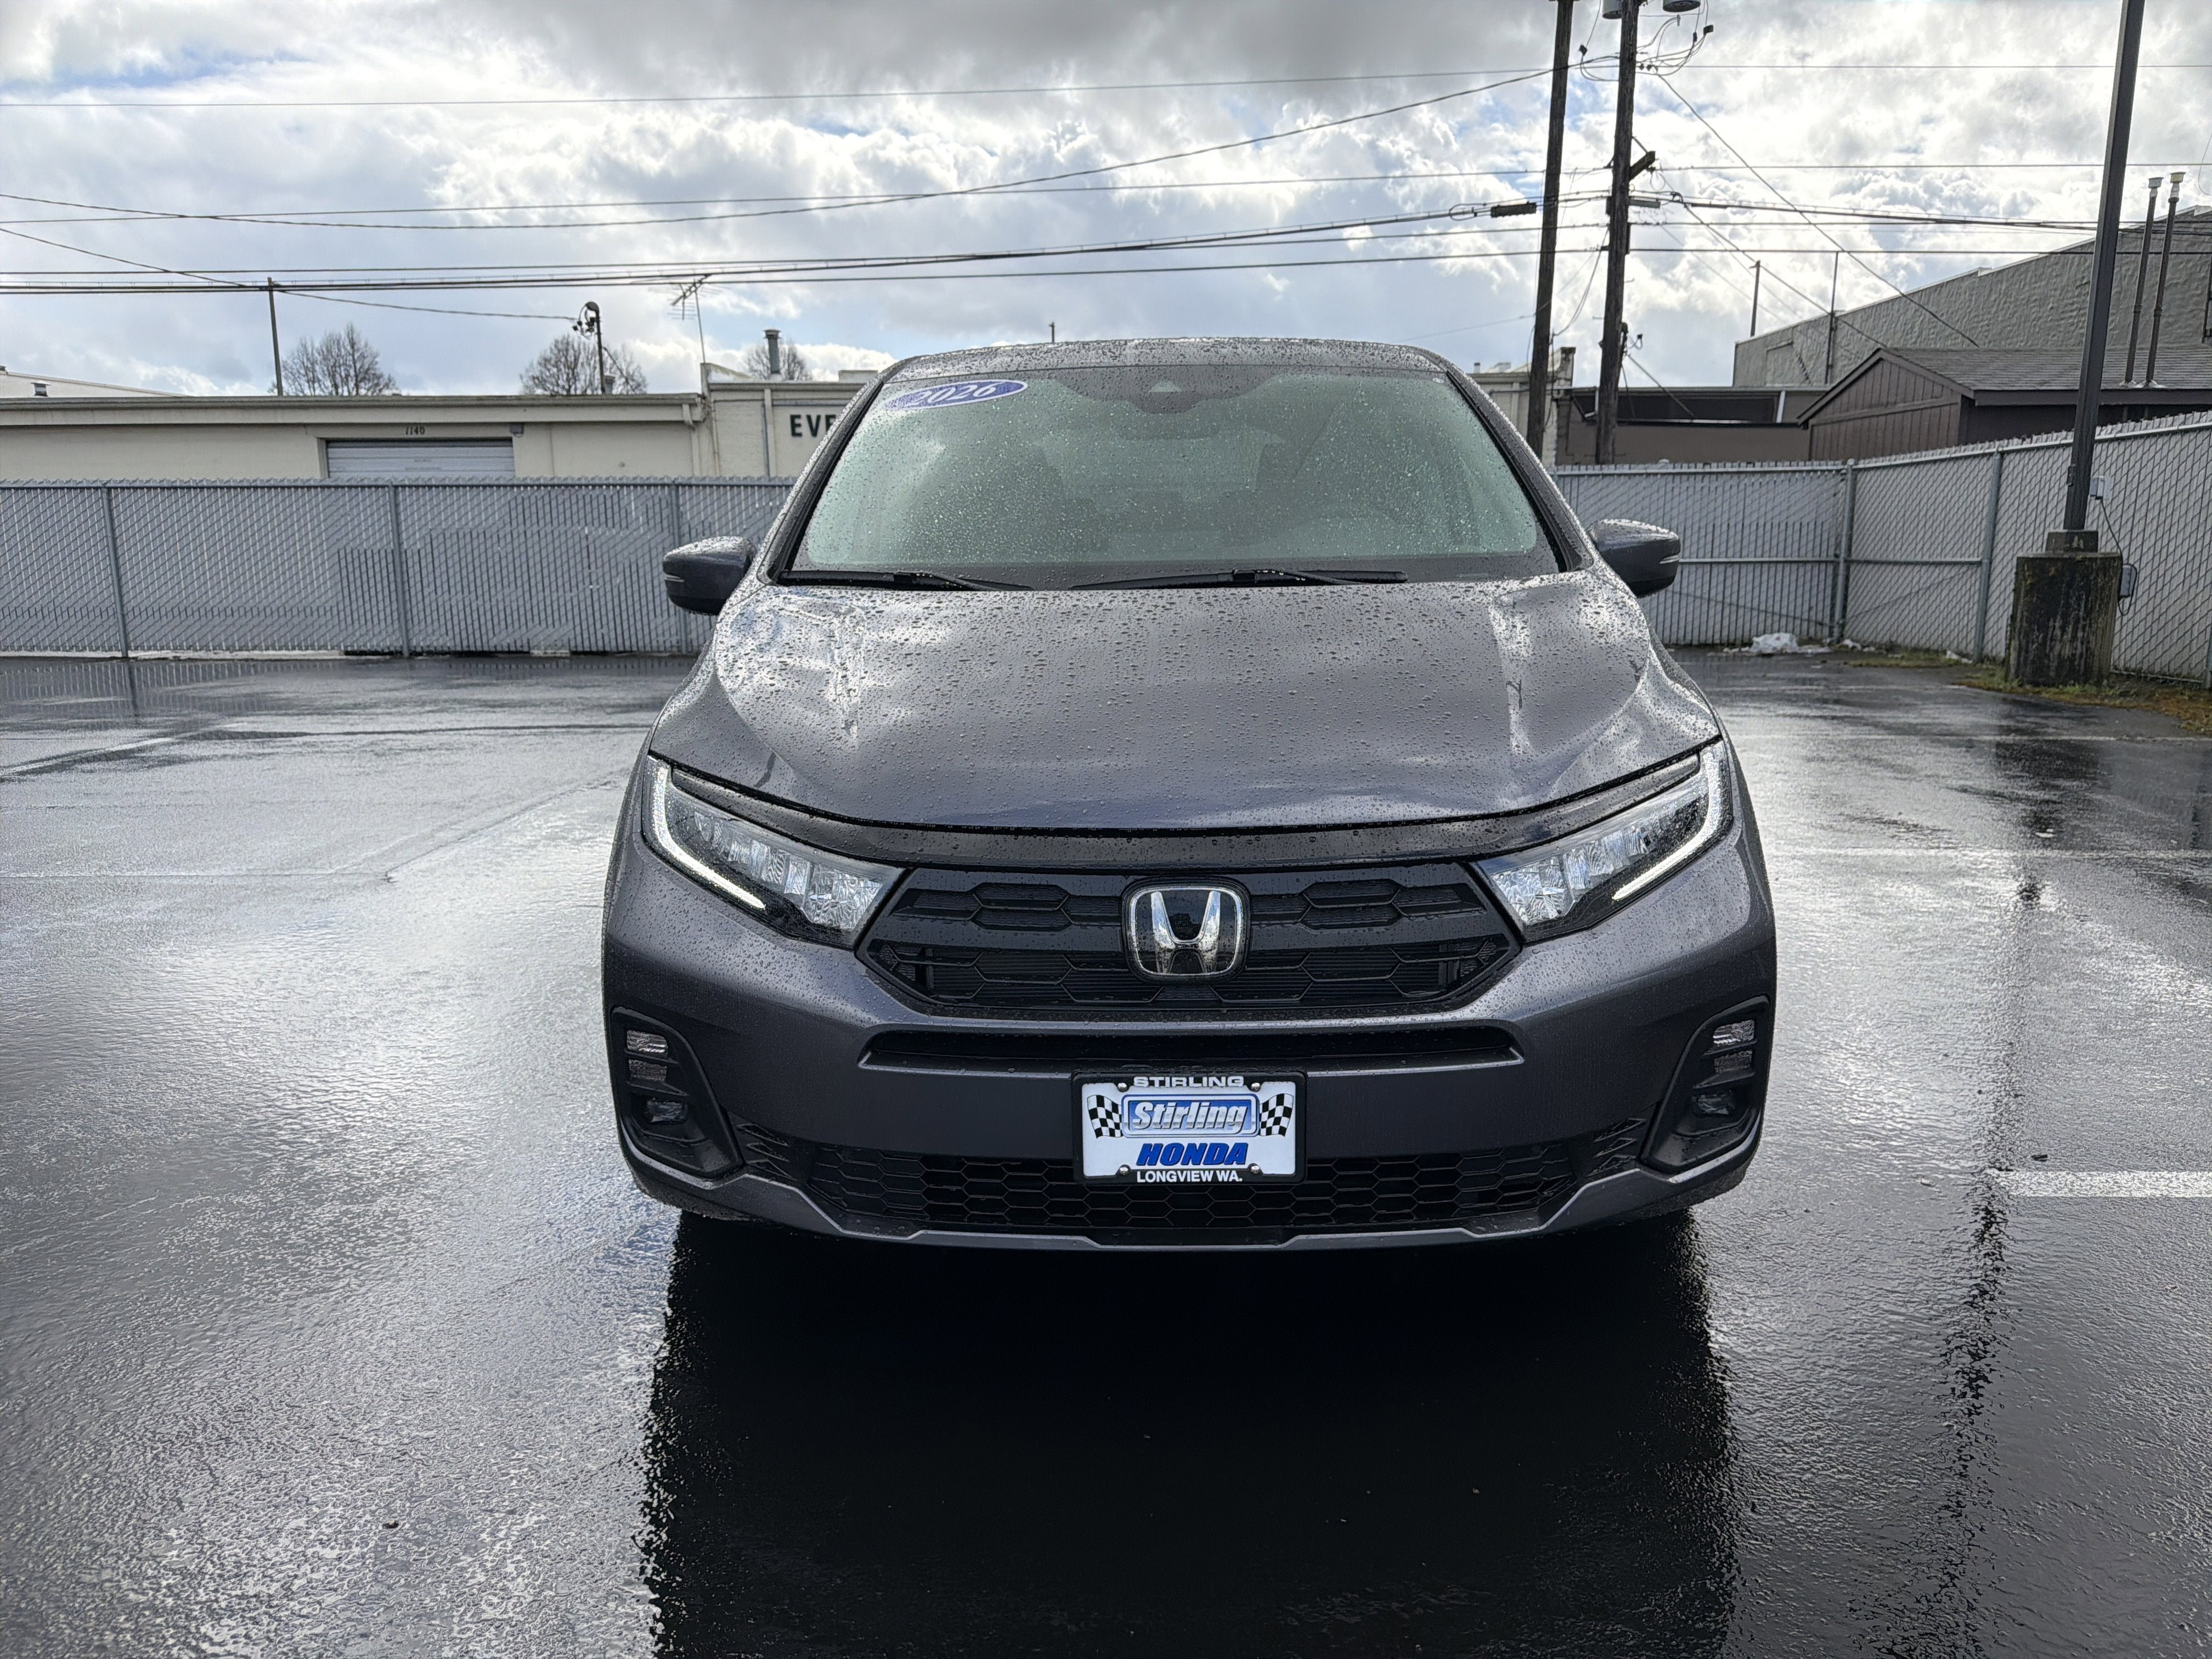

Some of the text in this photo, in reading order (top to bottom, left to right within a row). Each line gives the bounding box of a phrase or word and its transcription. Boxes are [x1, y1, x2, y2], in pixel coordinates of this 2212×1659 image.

[905, 382, 1006, 407] 2026
[406, 425, 425, 435] 1140
[1133, 1076, 1244, 1087] STIRLING
[1132, 1101, 1248, 1133] Stirling
[1136, 1143, 1248, 1166] HONDA
[1137, 1170, 1243, 1182] LONGVIEW WA.
